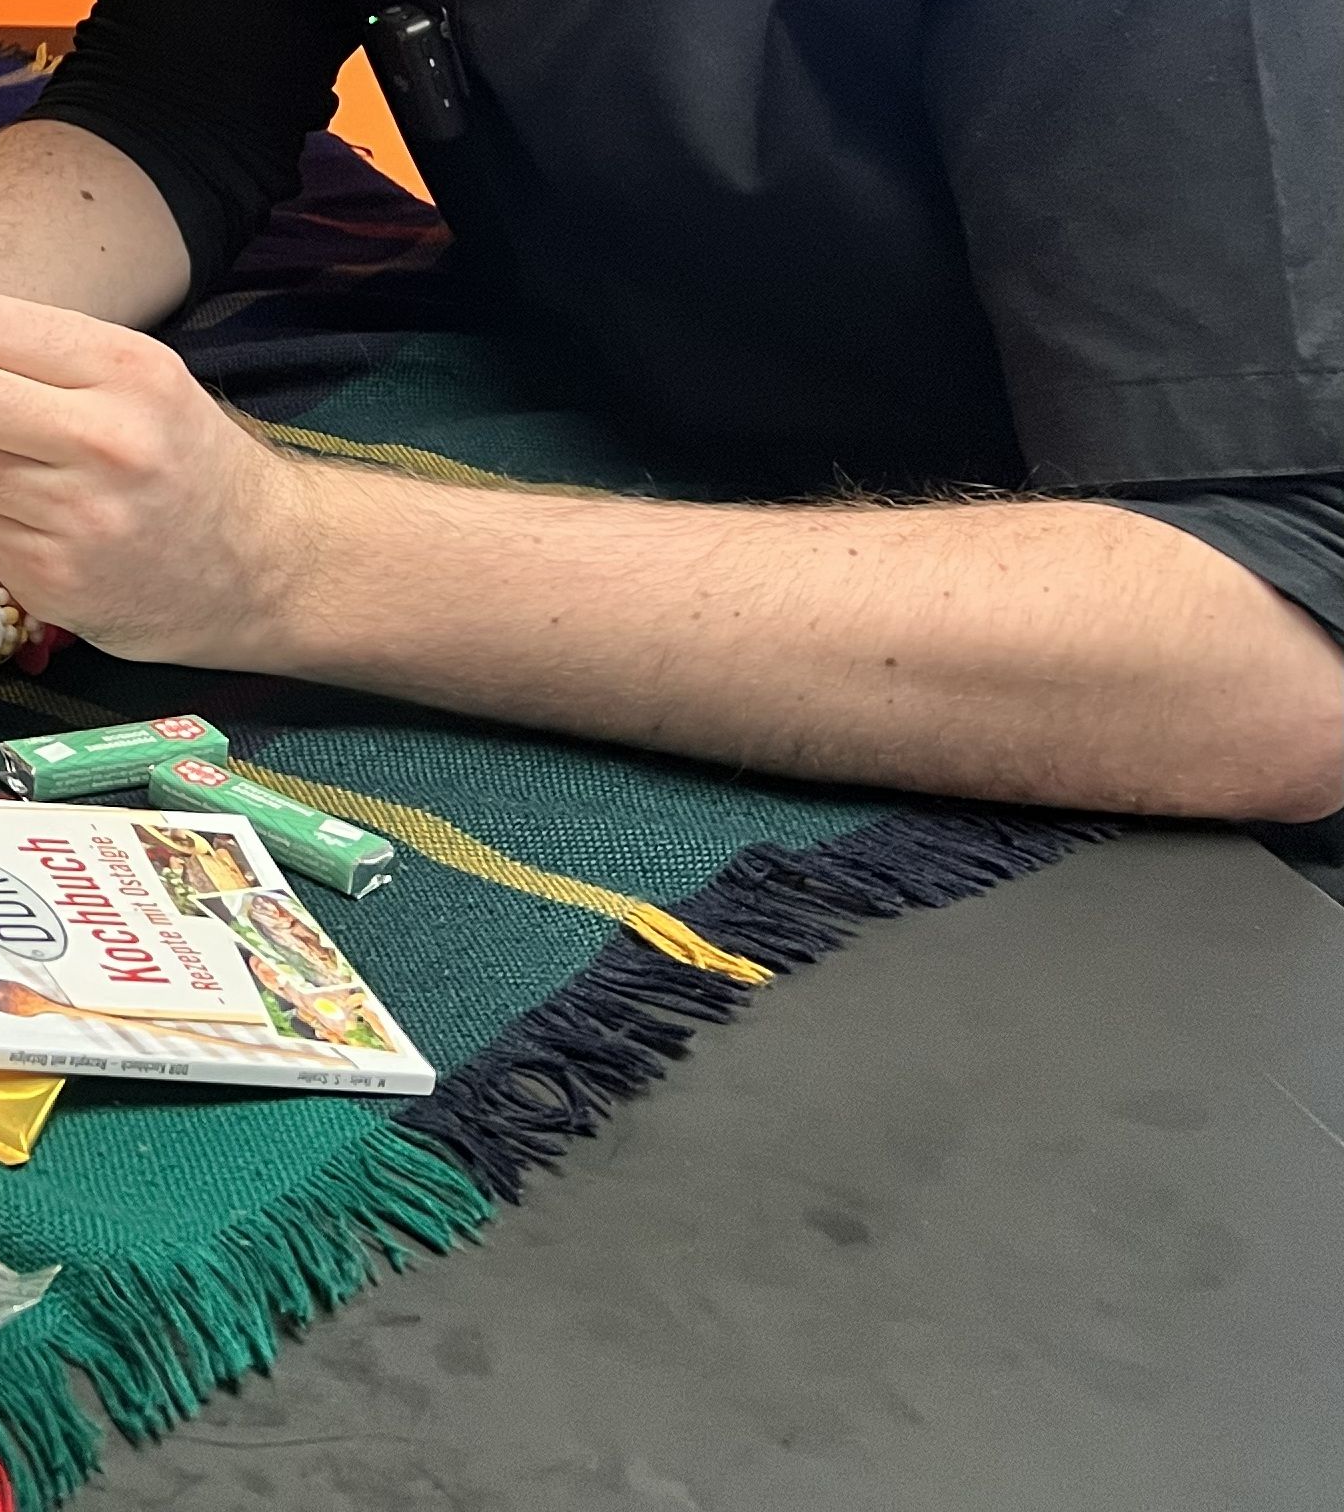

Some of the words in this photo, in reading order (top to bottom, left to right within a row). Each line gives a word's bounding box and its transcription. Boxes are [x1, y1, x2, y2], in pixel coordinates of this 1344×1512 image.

[89, 835, 150, 897] Ostalgie
[17, 837, 171, 984] Kochbuch
[129, 902, 173, 926] mit
[158, 930, 224, 991] Rezepte
